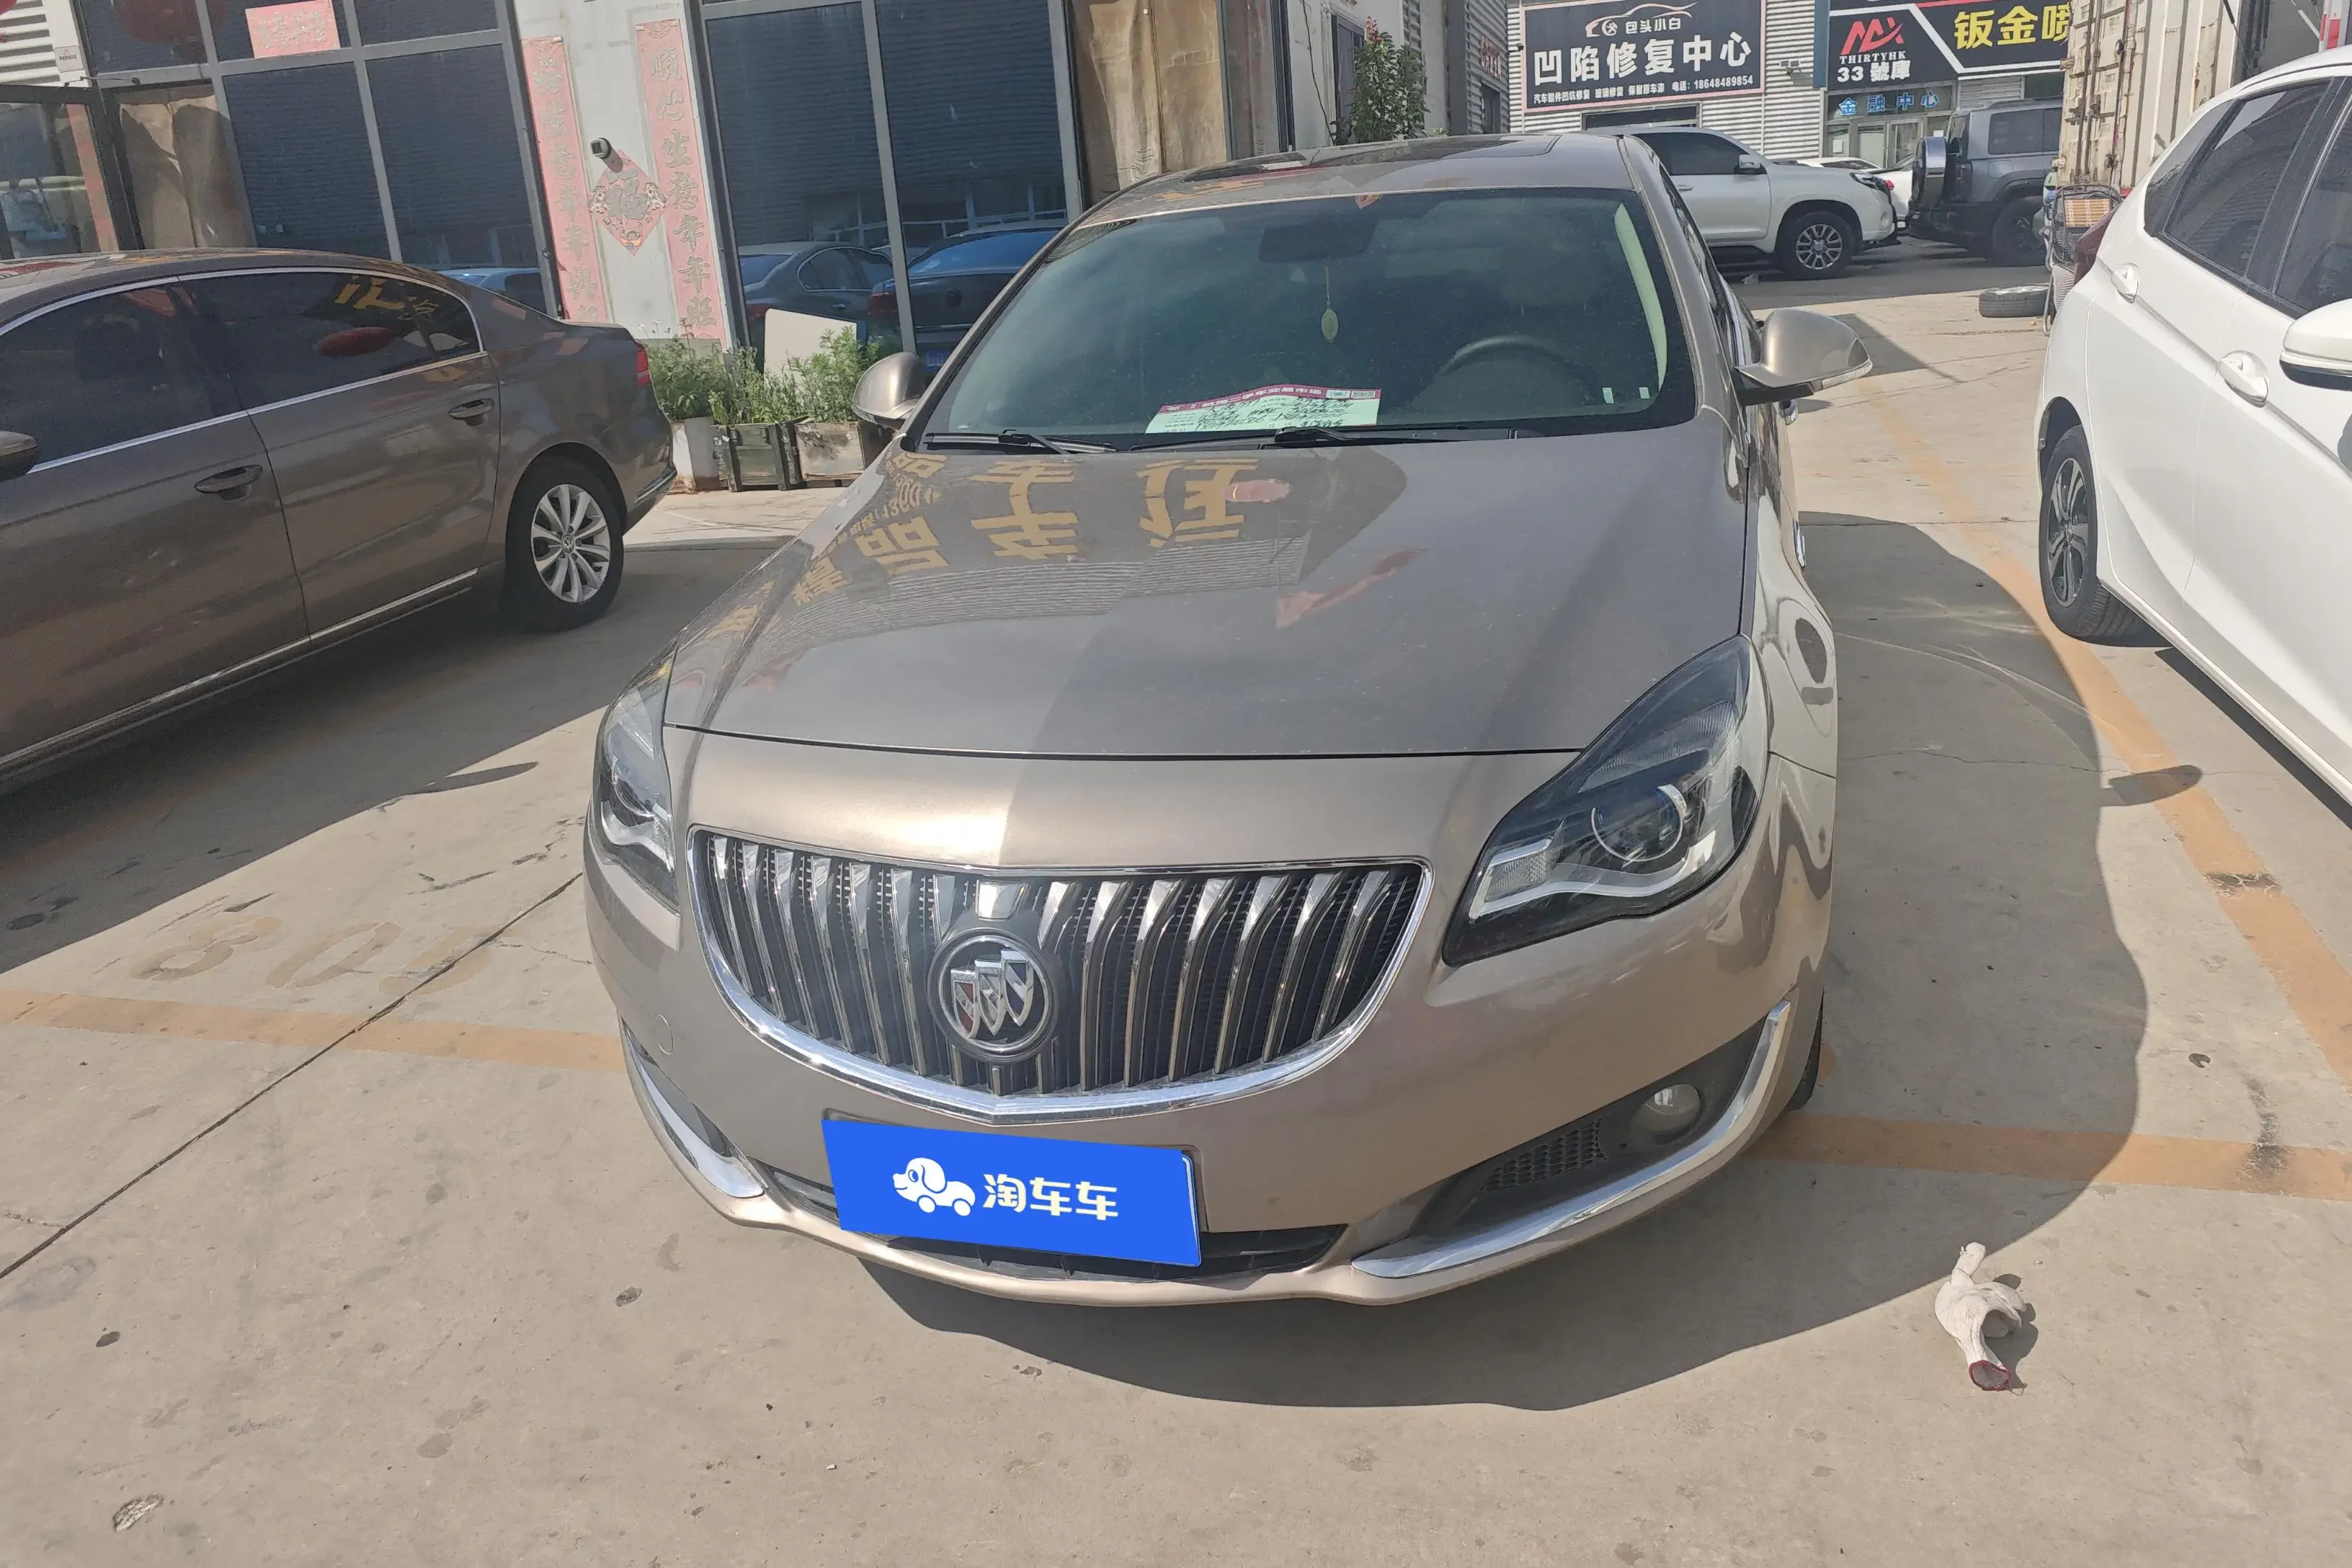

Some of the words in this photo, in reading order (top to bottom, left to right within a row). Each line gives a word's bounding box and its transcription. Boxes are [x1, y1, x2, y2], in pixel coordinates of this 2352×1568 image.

[1625, 17, 1682, 35] 包头小白
[1533, 31, 1752, 86] 凹陷修复中心
[1840, 50, 1907, 64] THIRTYHK
[1838, 90, 1941, 116] 金融中心
